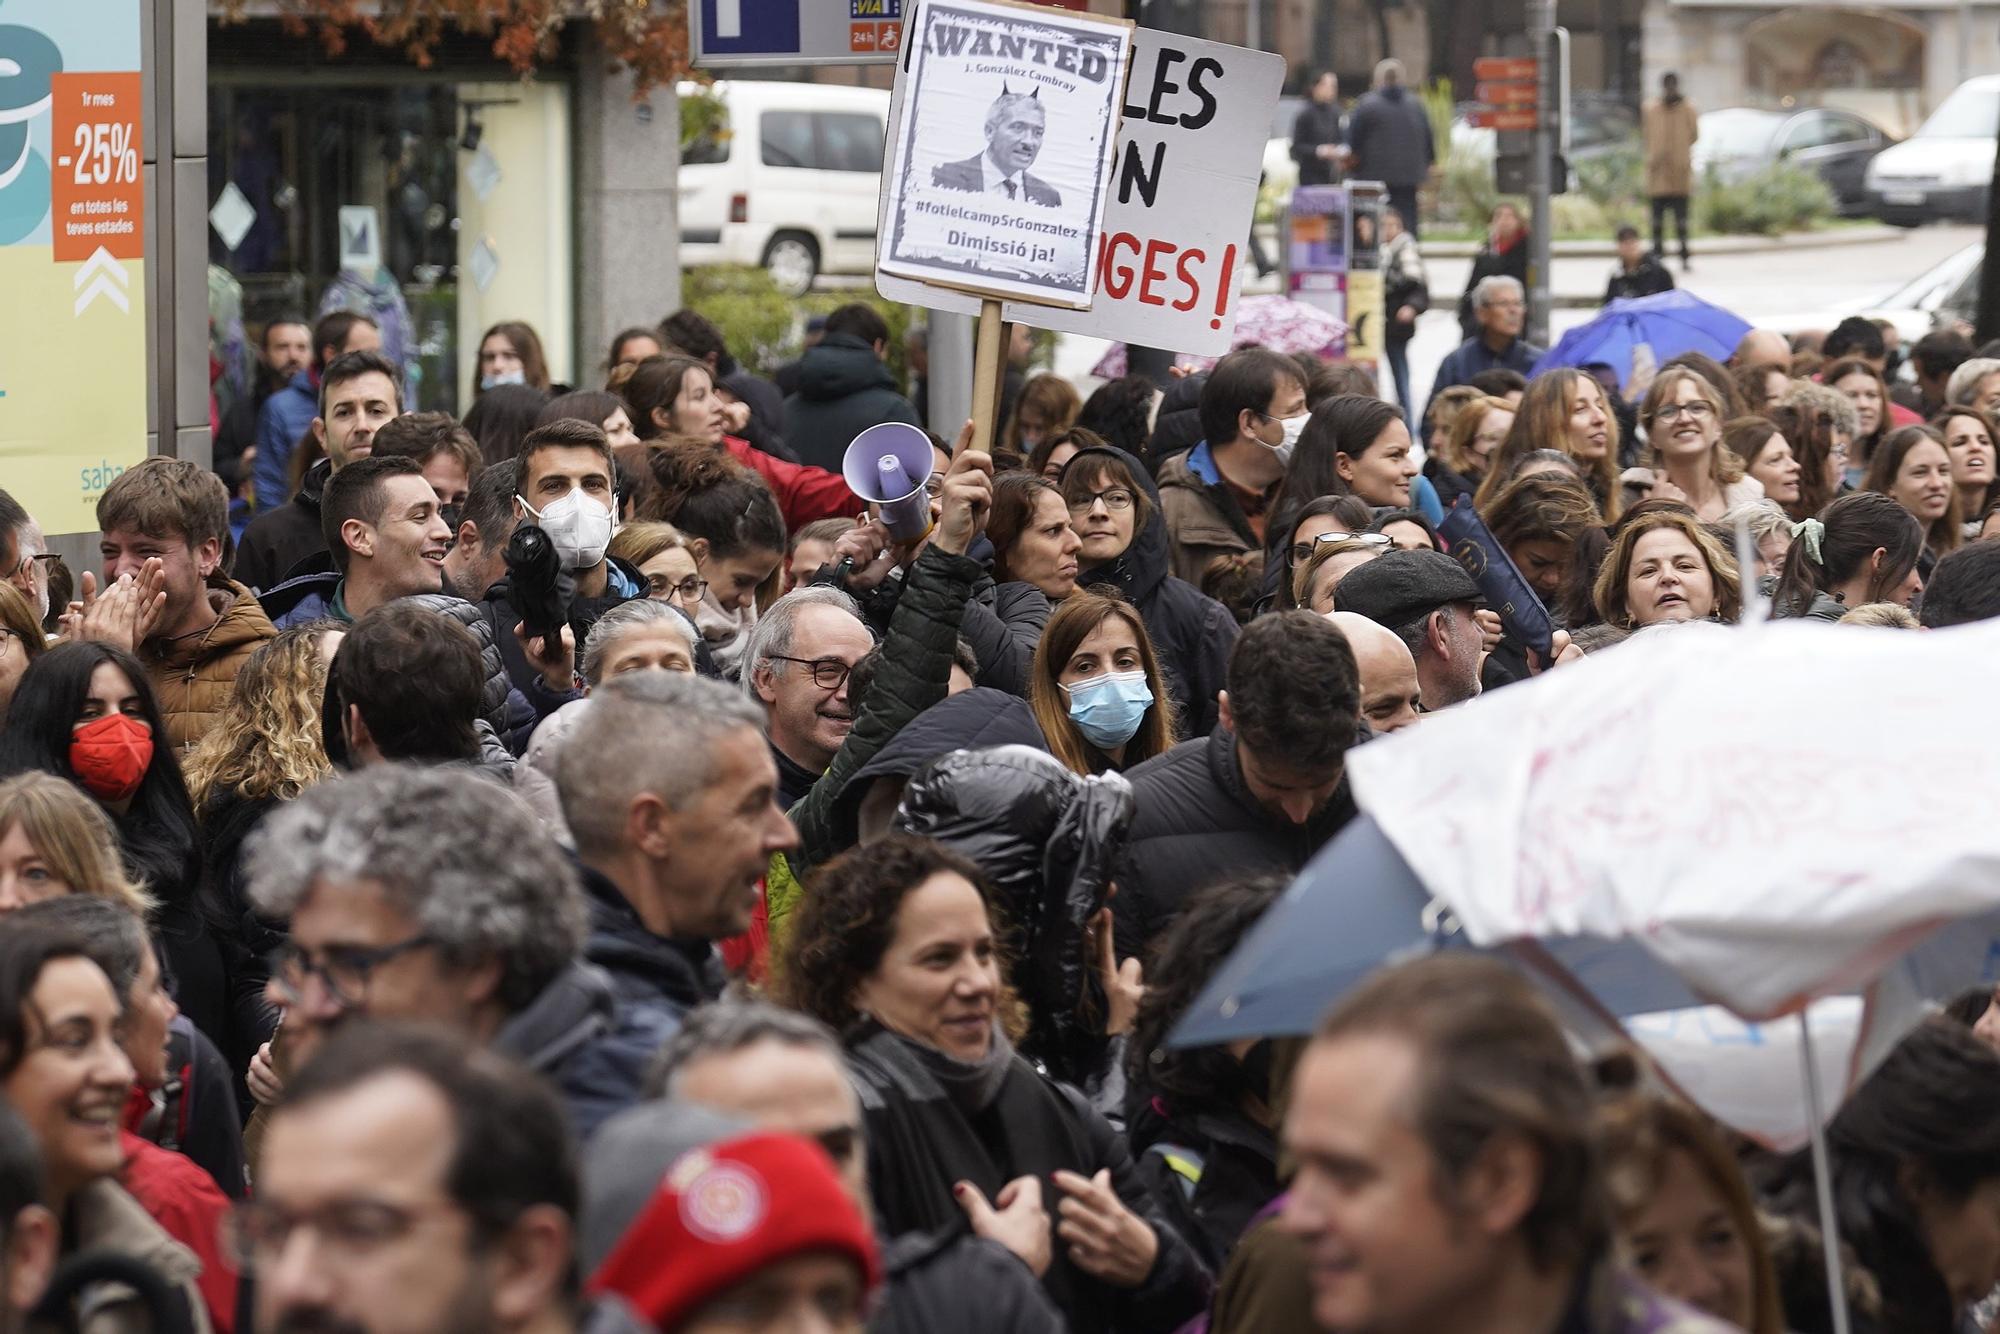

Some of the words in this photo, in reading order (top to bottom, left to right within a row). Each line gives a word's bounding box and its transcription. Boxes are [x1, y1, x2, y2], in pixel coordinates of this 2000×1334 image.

[934, 23, 1108, 84] WANTED
[975, 64, 1027, 77] González
[1028, 69, 1077, 93] Cambray
[81, 91, 92, 107] 1r
[93, 93, 115, 107] mes
[58, 122, 137, 184] -25%
[1110, 120, 1167, 208] N
[70, 201, 84, 214] en
[85, 199, 112, 214] totes
[113, 197, 128, 213] les
[66, 221, 94, 236] teves
[94, 218, 134, 234] estades
[947, 229, 1027, 257] Dimissió
[1030, 244, 1056, 263] ja!
